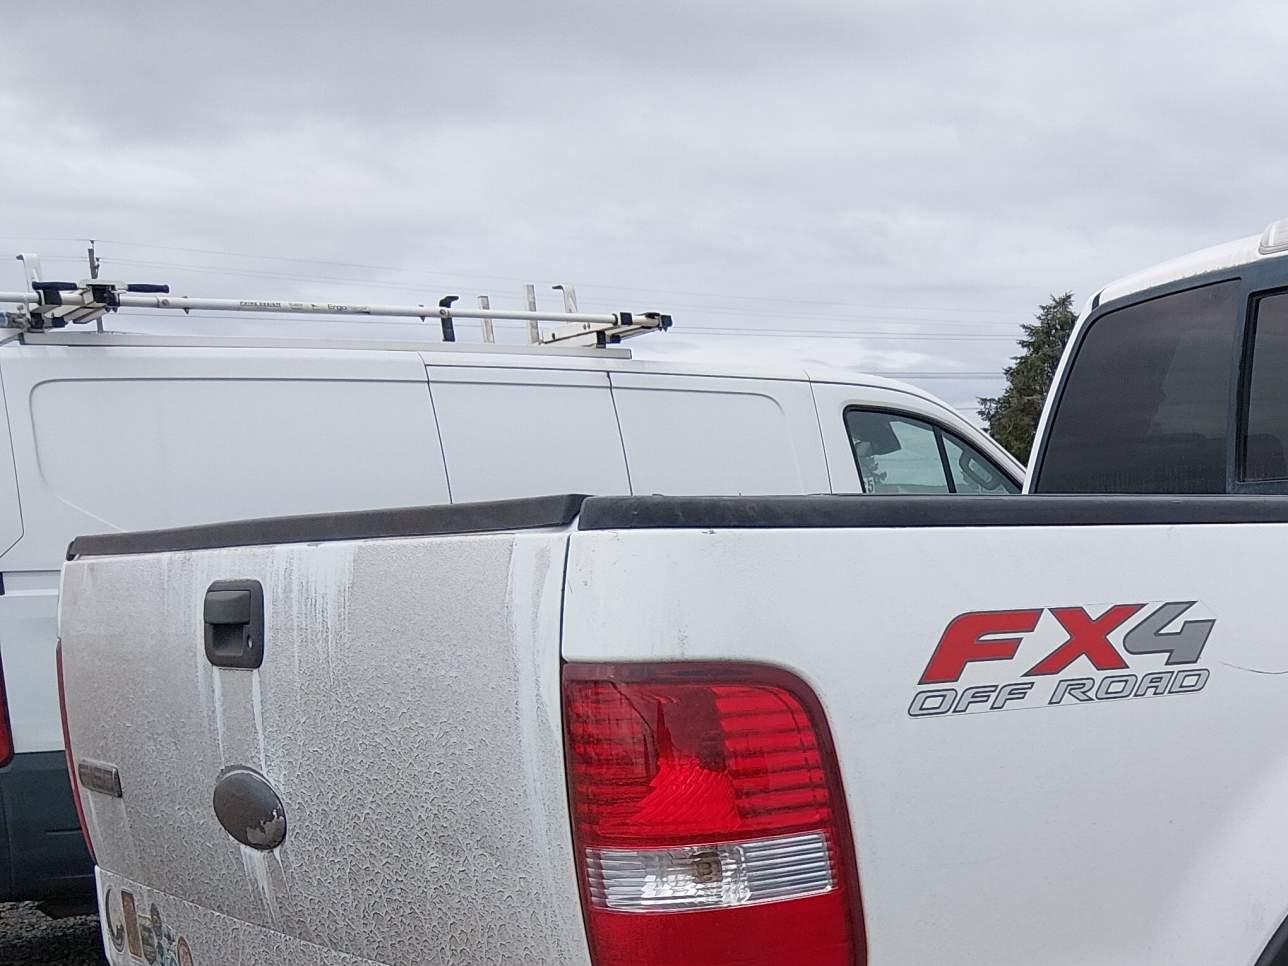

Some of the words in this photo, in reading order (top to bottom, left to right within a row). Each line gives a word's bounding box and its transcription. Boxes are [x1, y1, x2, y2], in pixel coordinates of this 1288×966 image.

[917, 600, 1217, 685] FX4
[907, 681, 1034, 718] OFF
[1048, 668, 1211, 705] ROAD
